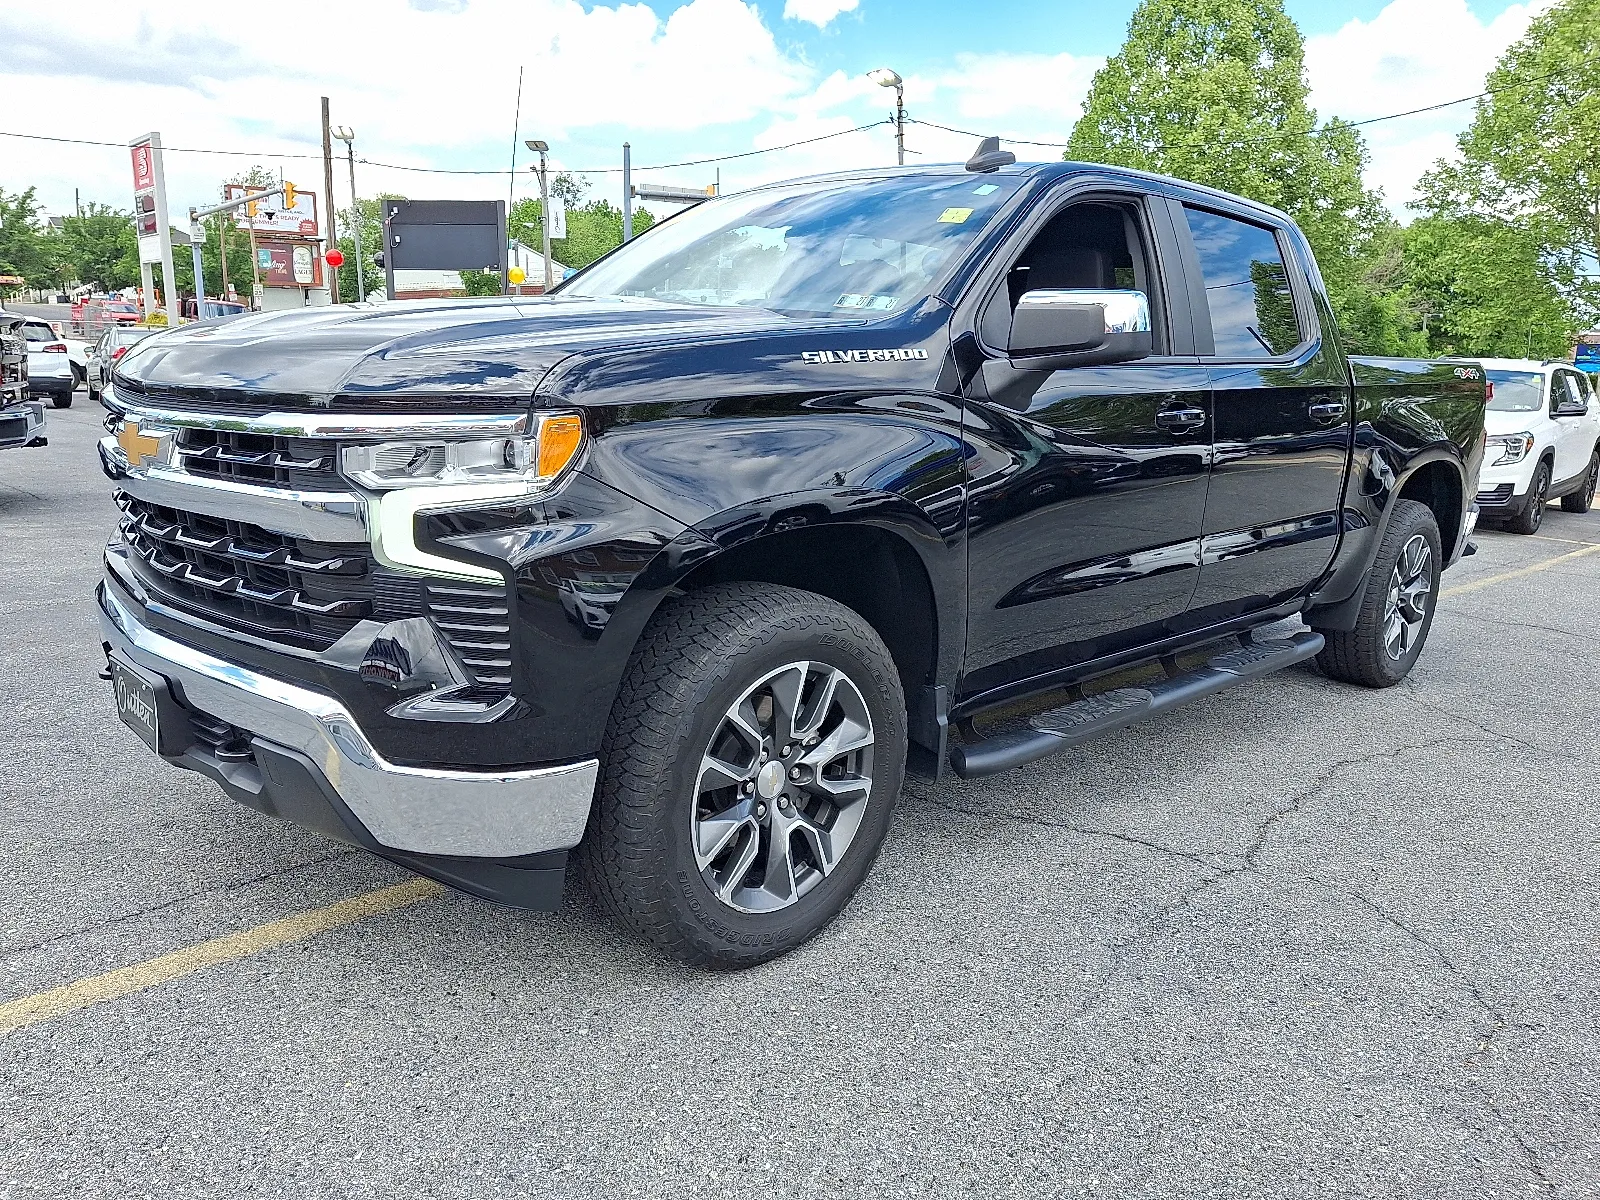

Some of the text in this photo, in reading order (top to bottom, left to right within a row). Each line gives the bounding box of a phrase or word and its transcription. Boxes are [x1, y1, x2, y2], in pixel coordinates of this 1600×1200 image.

[801, 348, 930, 365] SILVERADO
[818, 632, 892, 703] DUELER
[117, 675, 155, 731] Outten
[676, 869, 792, 948] BRIDGESTONE
